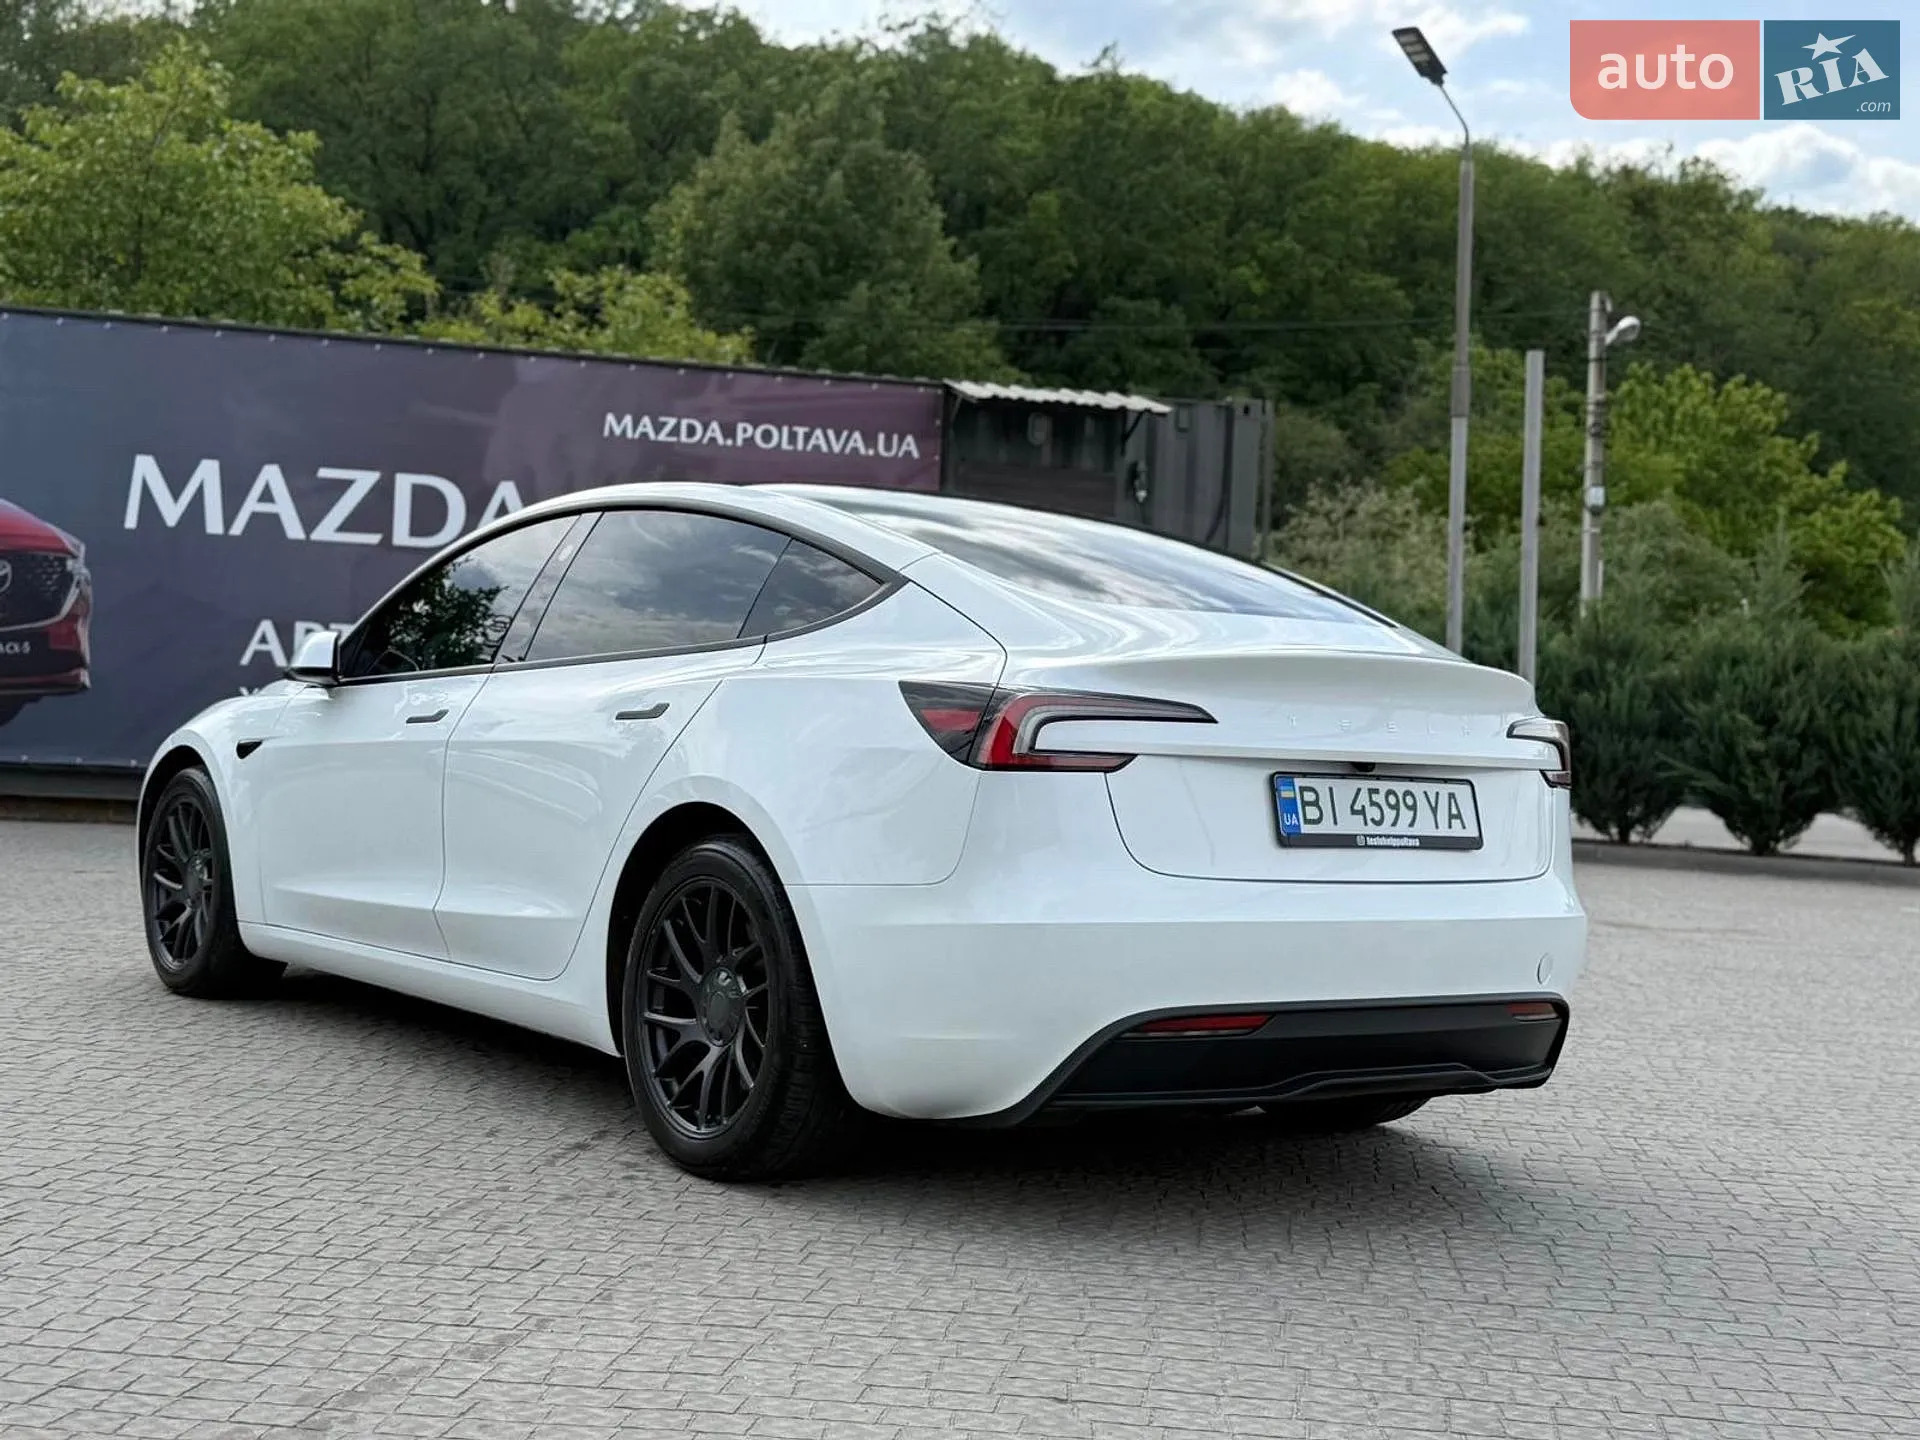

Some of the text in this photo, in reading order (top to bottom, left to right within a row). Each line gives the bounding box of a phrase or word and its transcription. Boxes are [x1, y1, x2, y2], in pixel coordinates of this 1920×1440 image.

[603, 412, 920, 460] MAZDA.POLTAVA.UA
[1283, 813, 1299, 826] UA
[1299, 786, 1467, 830] BI 4599 YA
